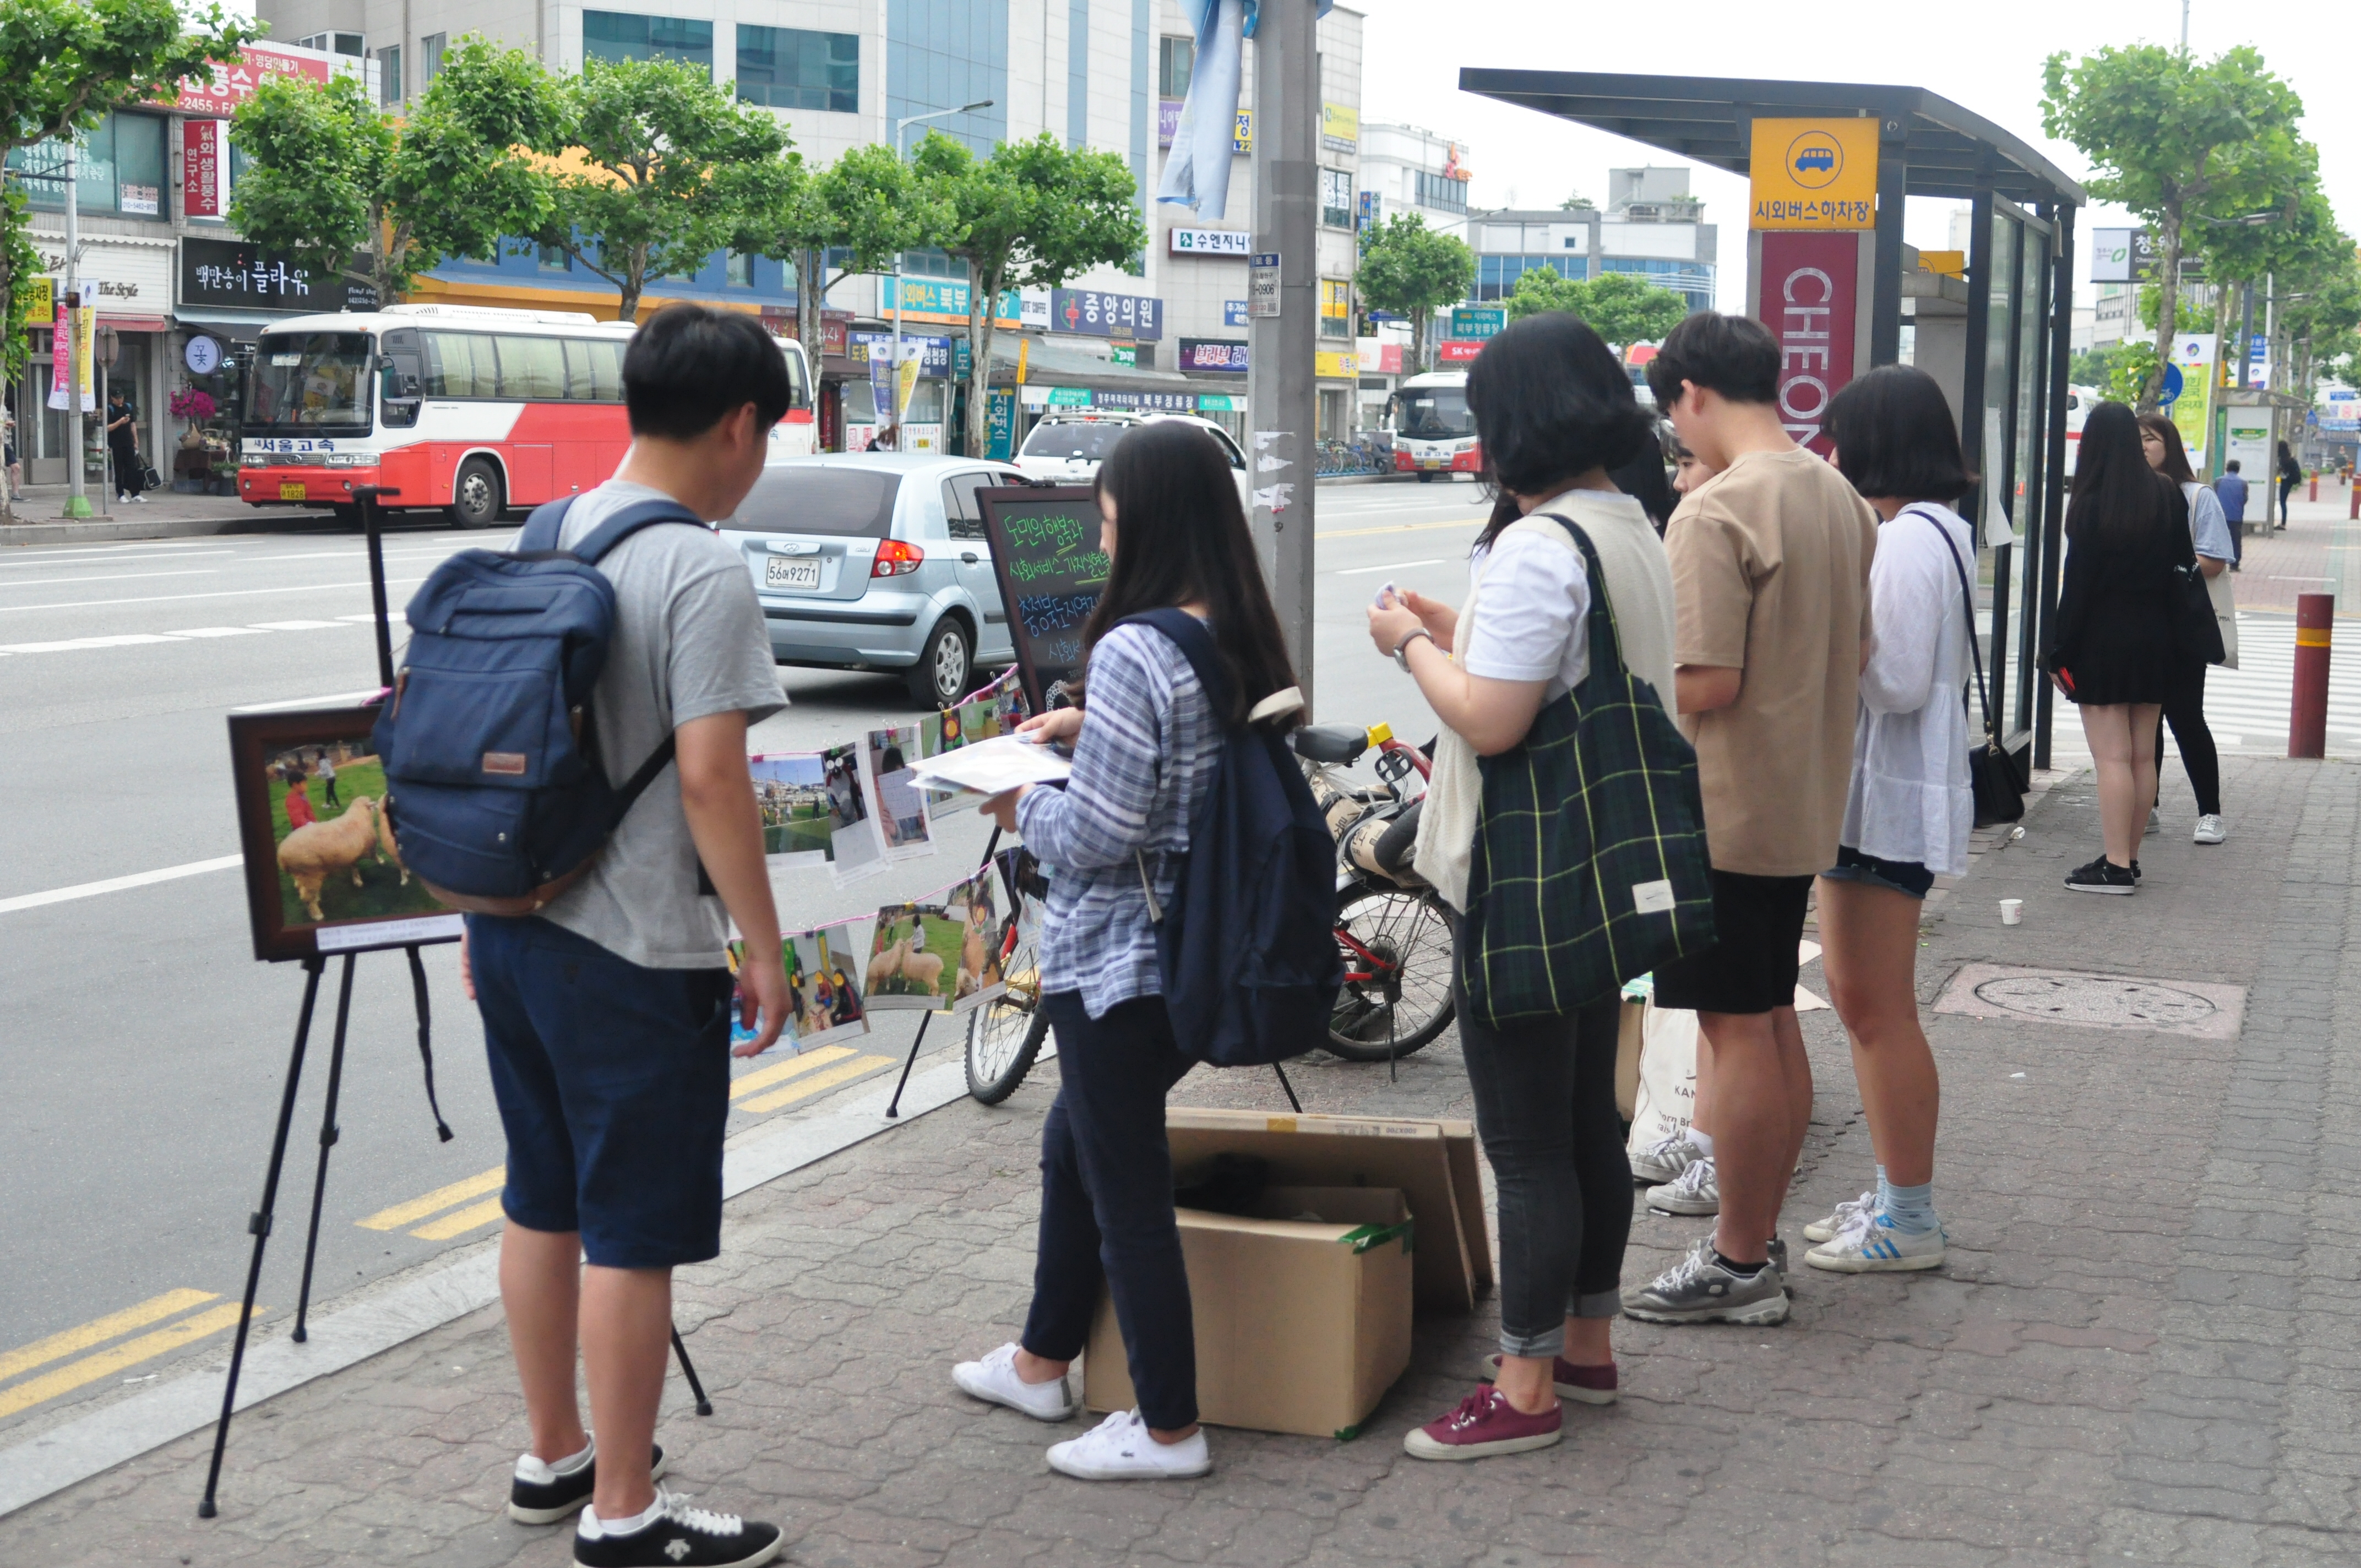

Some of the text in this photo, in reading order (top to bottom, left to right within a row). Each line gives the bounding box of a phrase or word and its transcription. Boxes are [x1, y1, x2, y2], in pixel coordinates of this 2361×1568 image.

[187, 148, 199, 193] 연구소
[1197, 233, 1250, 250] 수엔지니
[99, 281, 139, 300] The Style
[195, 265, 248, 292] 백만송이
[1084, 292, 1153, 328] 중앙의원
[1451, 346, 1464, 356] SK
[1004, 514, 1084, 547] 도민의 행복과
[1010, 556, 1064, 582] 사회서비스
